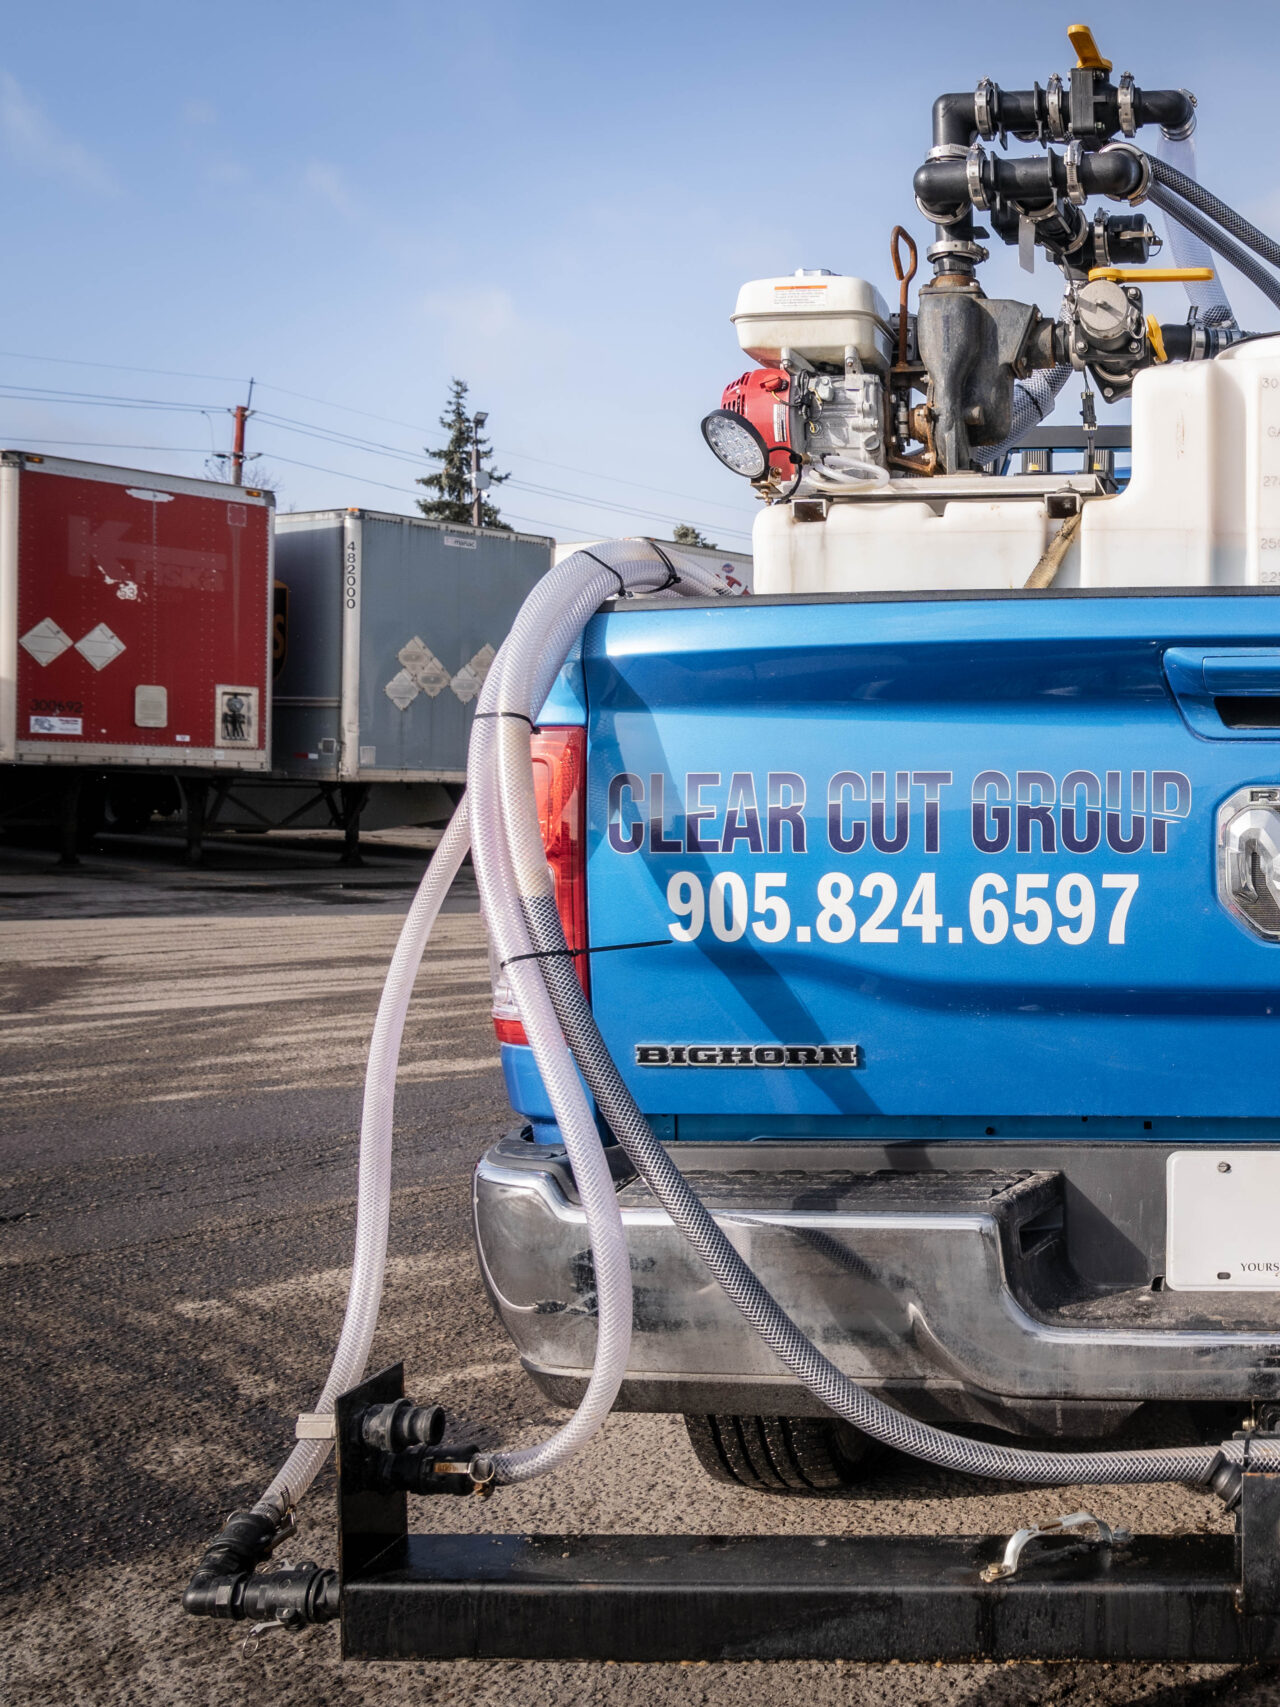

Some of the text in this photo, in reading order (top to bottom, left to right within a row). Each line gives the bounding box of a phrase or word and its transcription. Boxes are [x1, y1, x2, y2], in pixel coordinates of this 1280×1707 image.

[346, 541, 356, 609] 482000
[607, 770, 1193, 854] CLEAR CUT GROUP
[666, 871, 1141, 945] 905.824.6597
[634, 1043, 858, 1067] BIGHORN
[1240, 1262, 1280, 1272] YOURS
